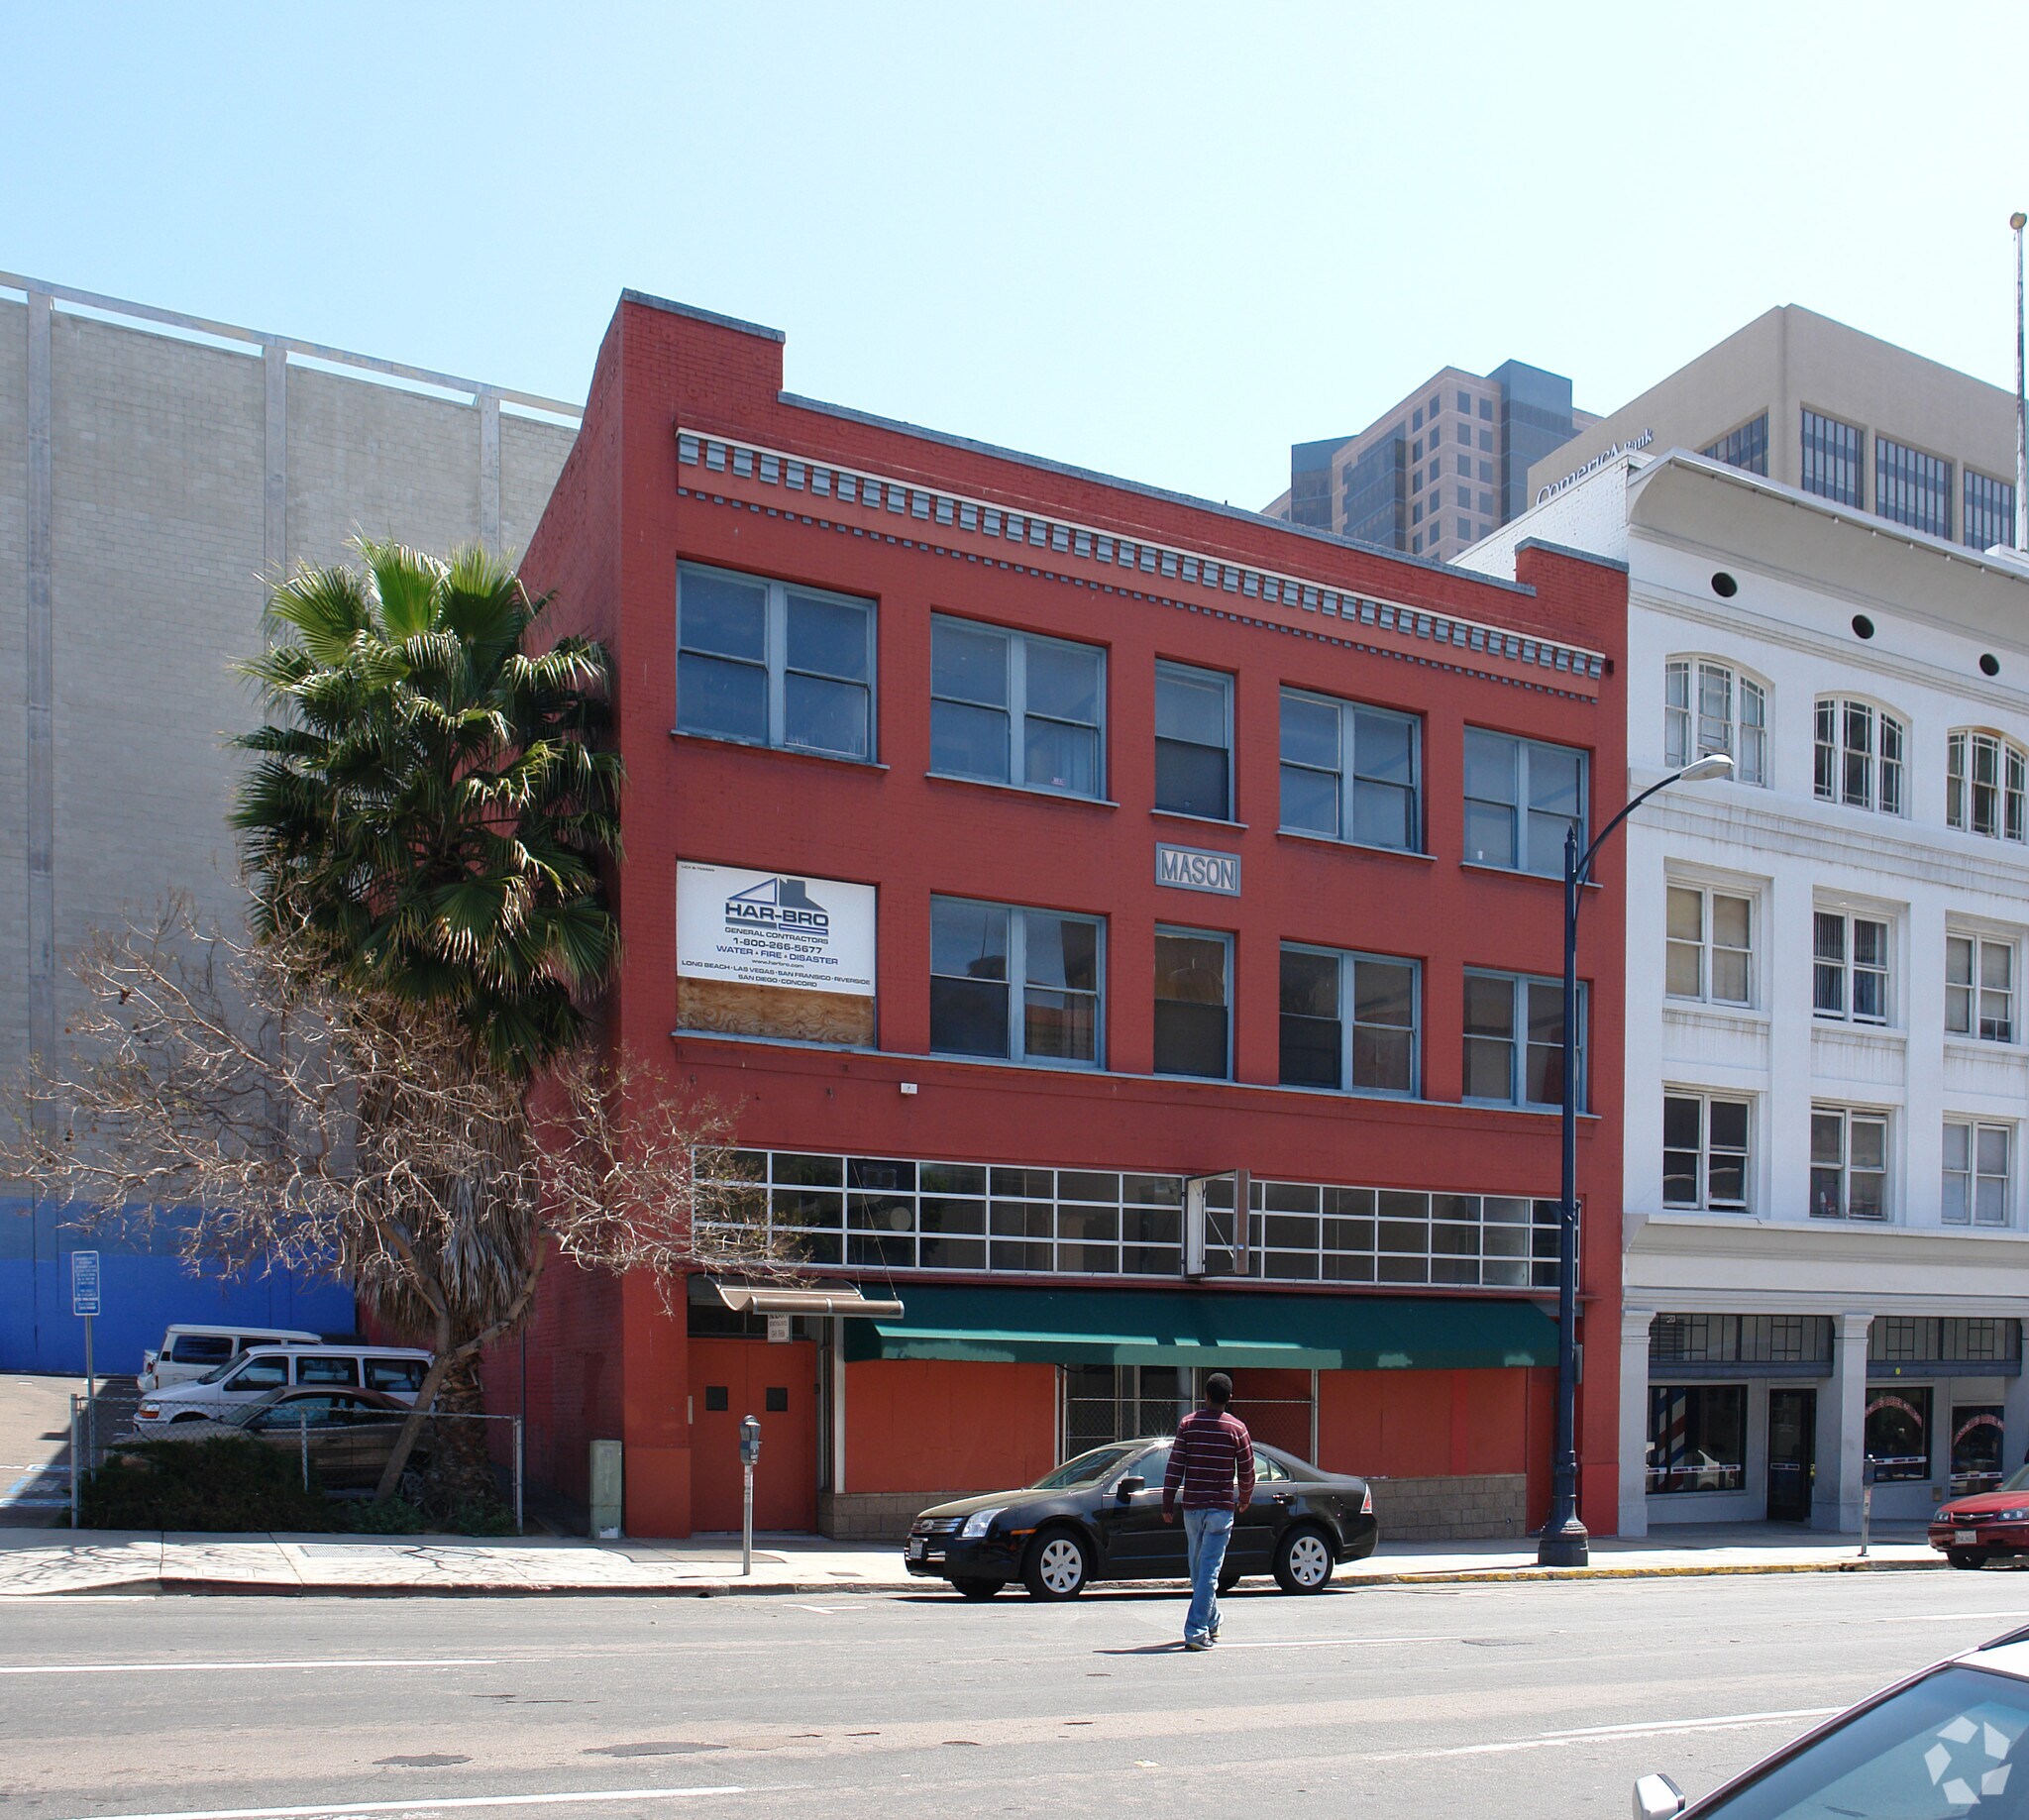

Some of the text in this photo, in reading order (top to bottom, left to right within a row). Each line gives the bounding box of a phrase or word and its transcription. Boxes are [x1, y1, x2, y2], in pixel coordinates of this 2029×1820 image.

[1161, 851, 1234, 889] MASON
[725, 902, 829, 926] HAR-BRO
[724, 926, 829, 944] GENERAL CONTRACTORS
[716, 944, 839, 965] WATER FIRE DISASTER
[733, 937, 823, 954] 1-800-266-5677
[834, 976, 871, 985] RIVERSIDE
